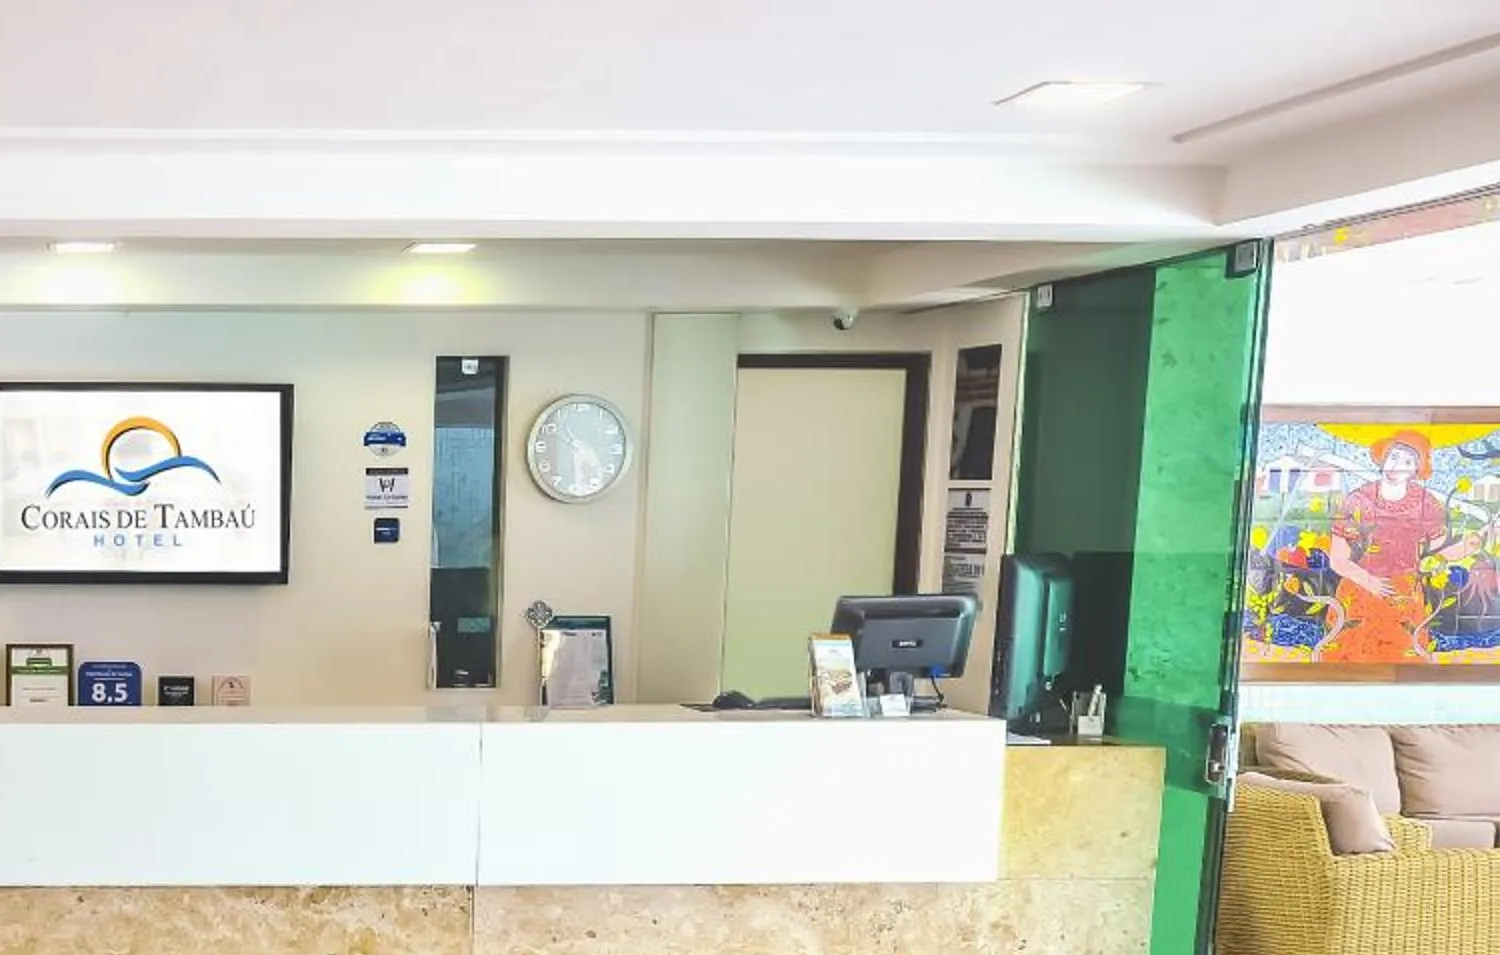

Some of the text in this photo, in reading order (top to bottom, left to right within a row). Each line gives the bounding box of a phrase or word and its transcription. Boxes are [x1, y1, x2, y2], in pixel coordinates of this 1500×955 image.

[21, 503, 256, 531] CORAIS DE TAMBAÚ
[93, 534, 182, 547] HOTEL
